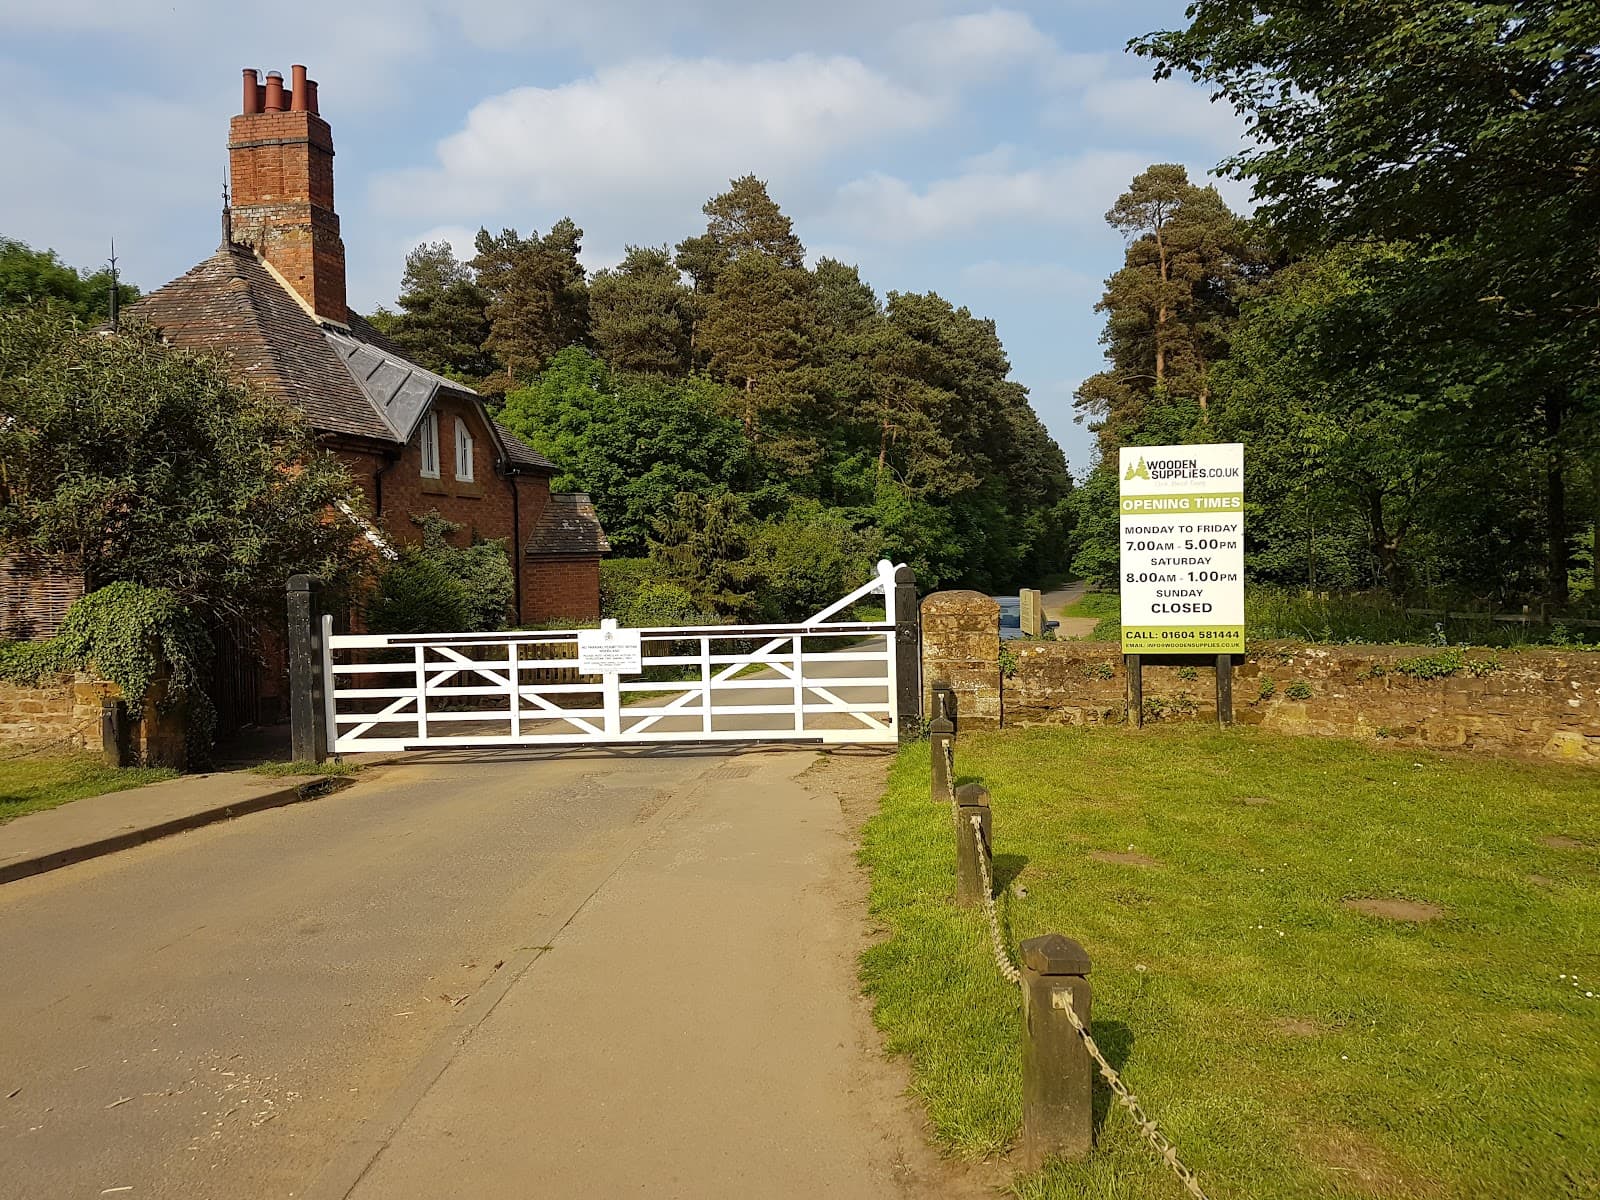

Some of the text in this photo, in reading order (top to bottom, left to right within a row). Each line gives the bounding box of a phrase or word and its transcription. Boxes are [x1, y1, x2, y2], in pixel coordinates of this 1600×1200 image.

[1146, 460, 1196, 470] WOODEN
[1122, 497, 1240, 510] OPENING TIMES
[1125, 526, 1174, 534] MONDAY
[1126, 541, 1174, 550] 7.00AM
[1185, 539, 1237, 550] 5.00PM
[1151, 557, 1211, 565] SATURDAY
[1126, 572, 1176, 582] 8.00AM
[1188, 571, 1237, 582] 1.00PM
[1151, 603, 1212, 613] CLOSED
